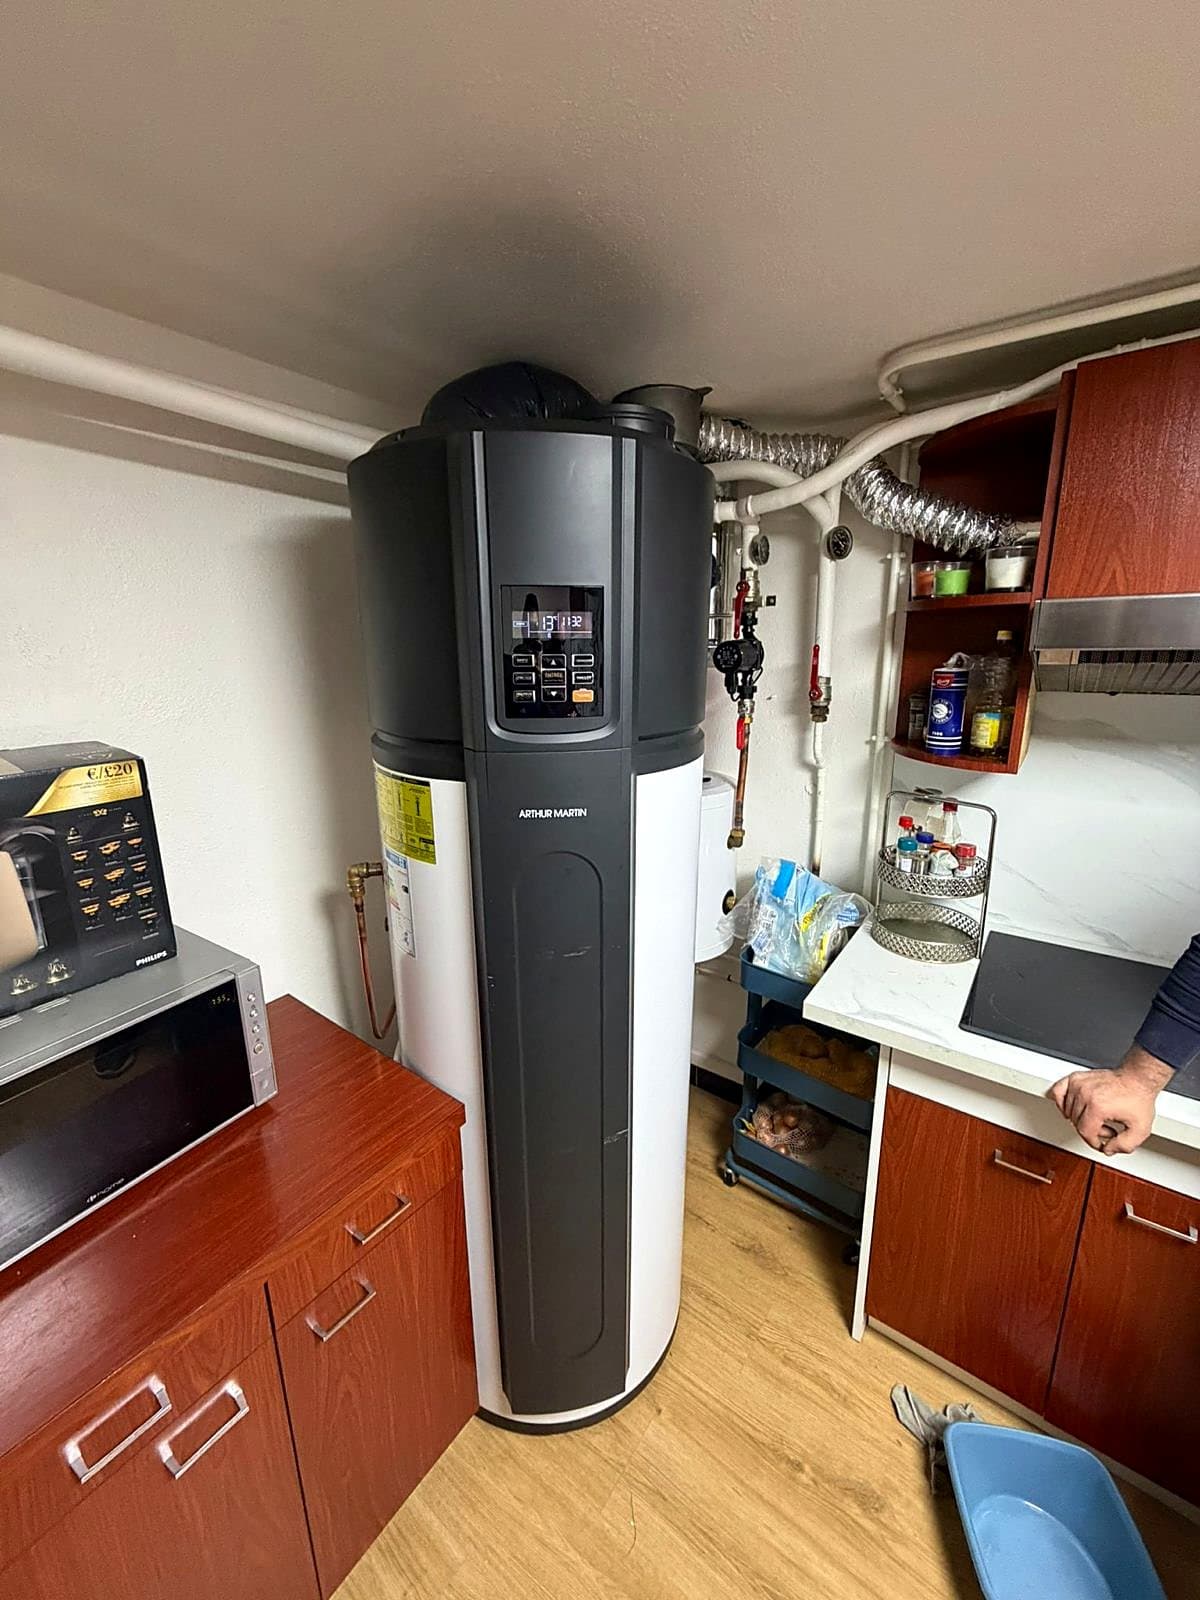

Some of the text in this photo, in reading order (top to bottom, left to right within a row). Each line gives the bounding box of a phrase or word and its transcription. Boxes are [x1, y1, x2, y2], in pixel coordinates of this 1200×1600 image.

[519, 808, 587, 818] ARTHUR MARTIN
[135, 950, 167, 966] PHILIPS
